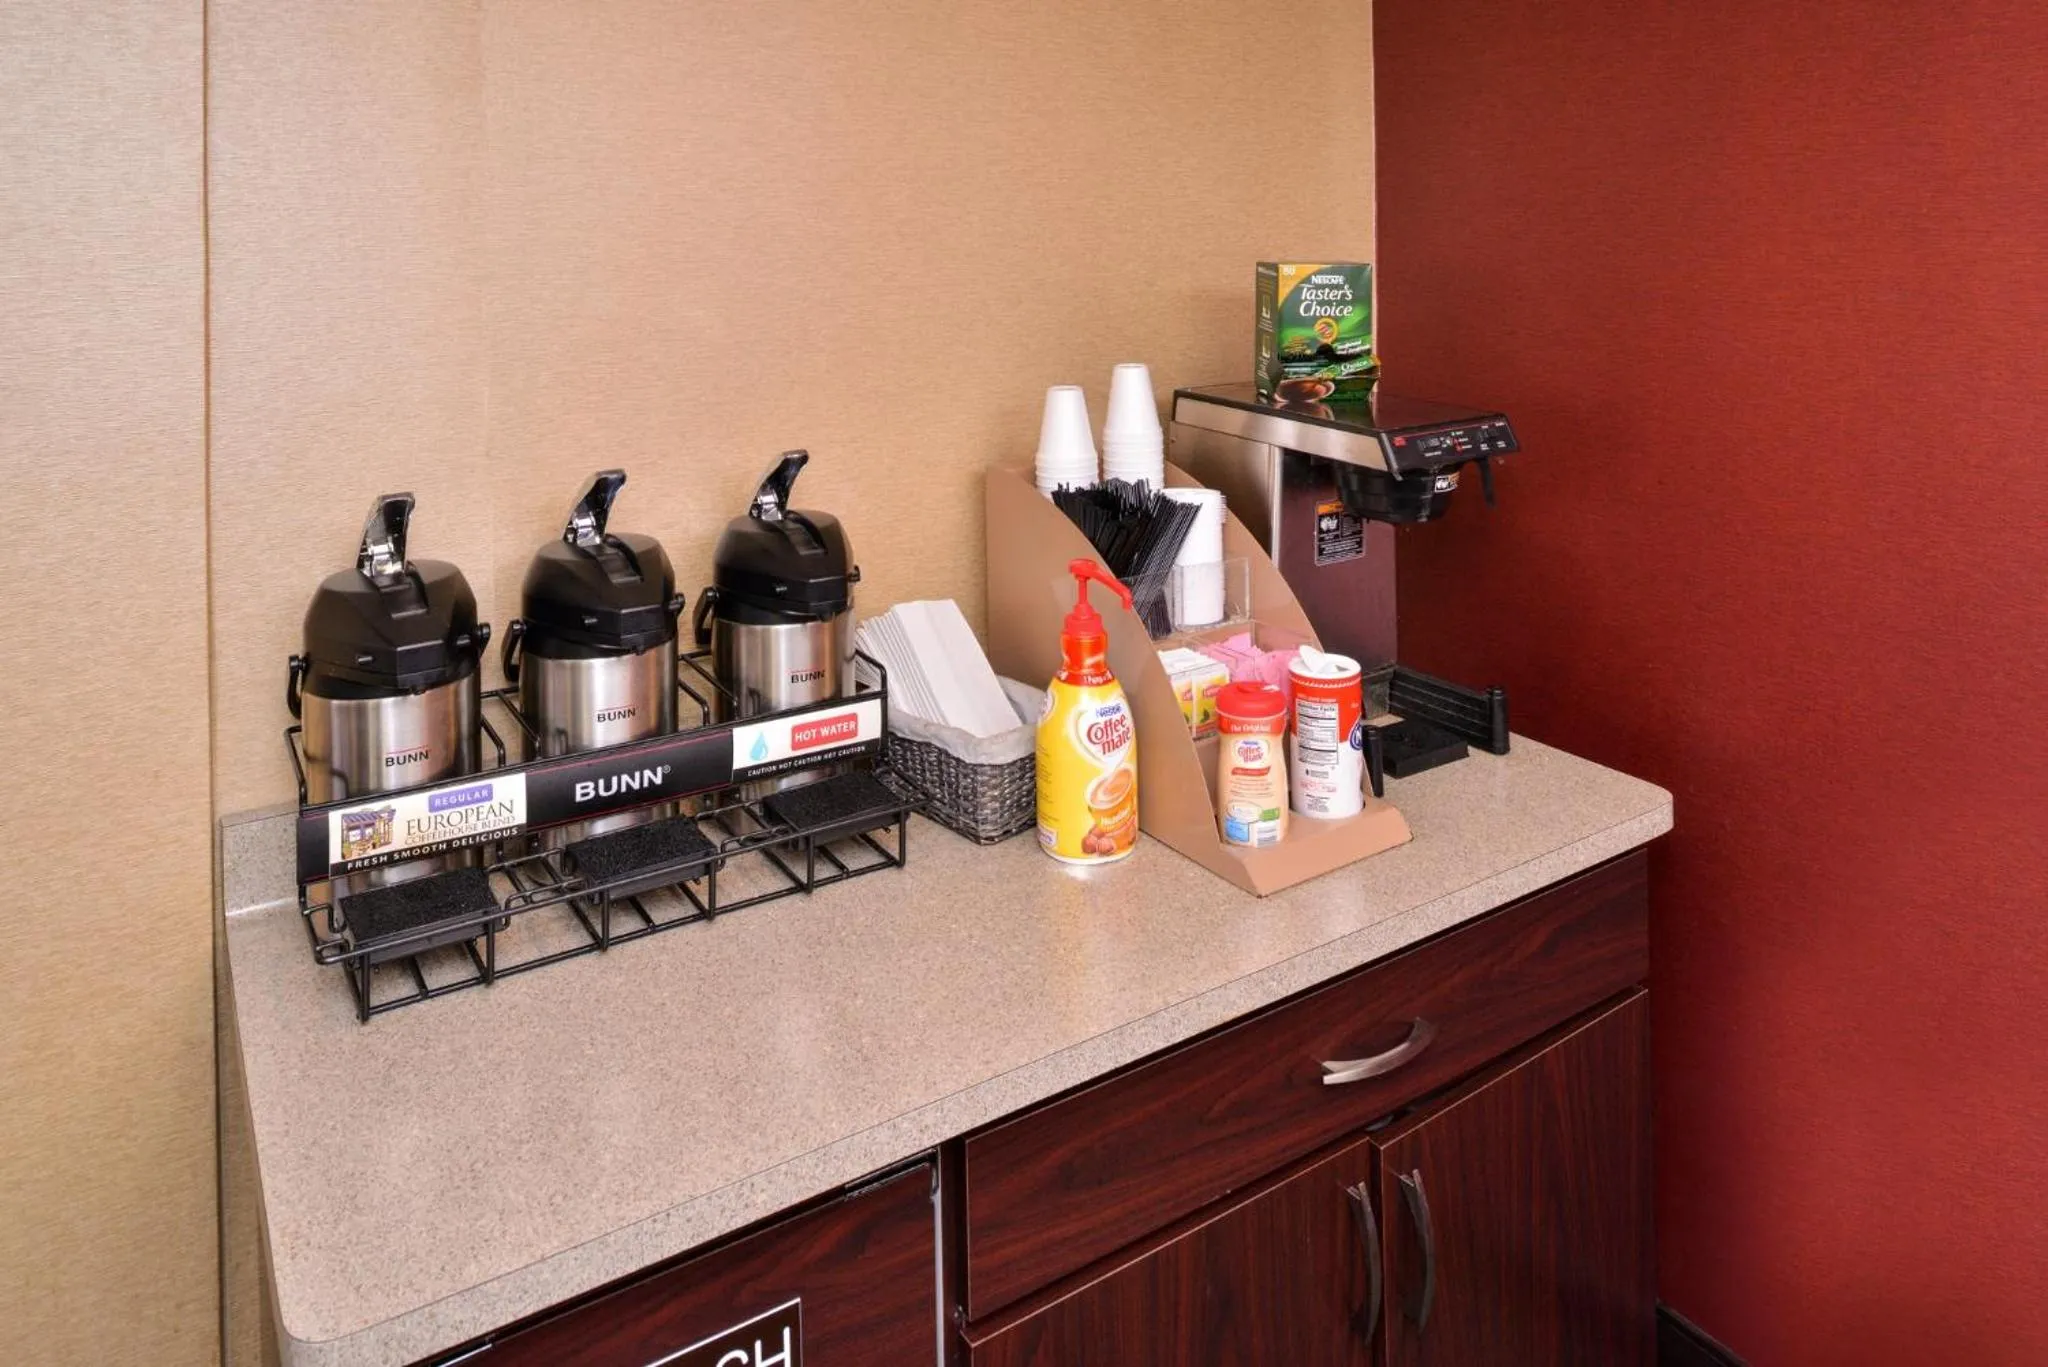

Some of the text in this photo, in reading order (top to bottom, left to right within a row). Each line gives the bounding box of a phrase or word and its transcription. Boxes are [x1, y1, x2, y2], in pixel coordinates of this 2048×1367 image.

[1300, 283, 1354, 301] Taster's
[1300, 300, 1354, 317] Choice
[791, 670, 825, 684] BUNN
[597, 707, 636, 723] BUNN
[795, 720, 857, 743] HOT WATER
[1087, 713, 1127, 745] Coffee
[1101, 726, 1131, 756] mate
[385, 749, 430, 767] BUNN
[748, 764, 777, 777] CAUTION
[794, 755, 822, 767] CAUTION
[838, 745, 866, 757] CAUTION
[434, 789, 489, 807] REGULAR
[406, 799, 515, 837] EUROPEAN
[347, 827, 519, 871] FRESH SMOOTH DELICIOUS
